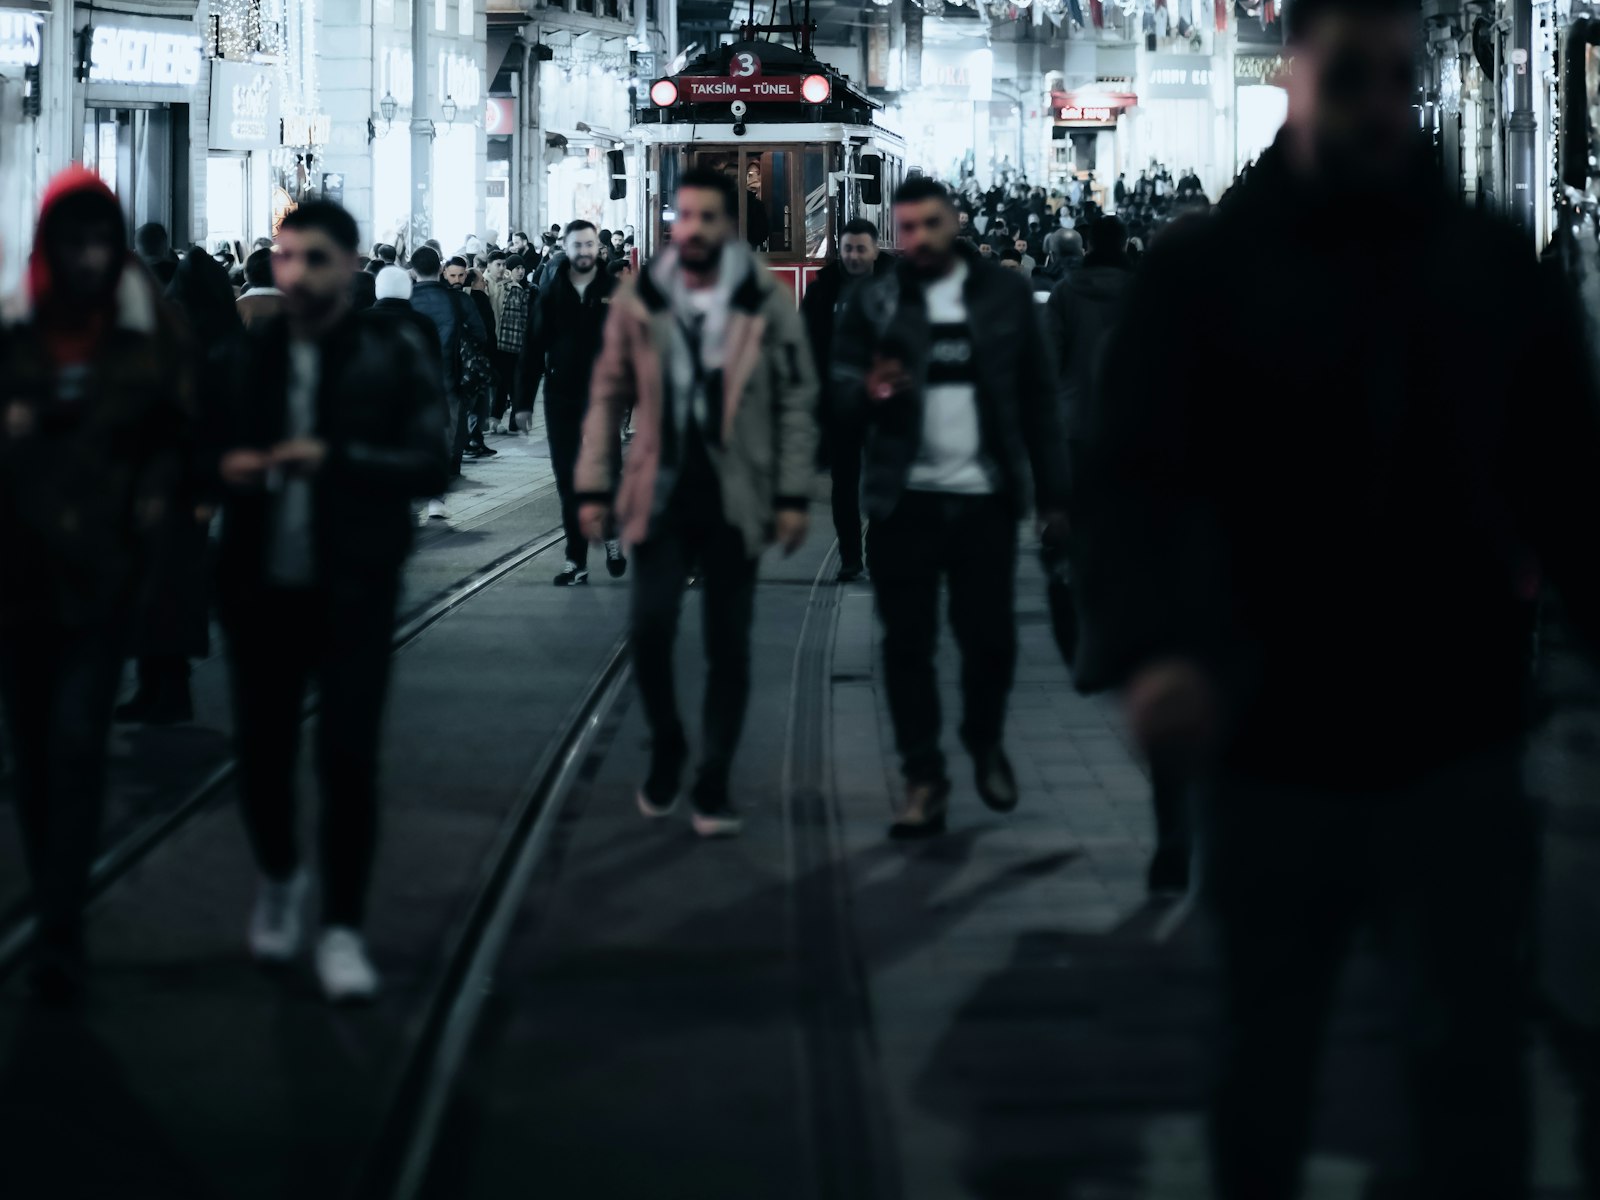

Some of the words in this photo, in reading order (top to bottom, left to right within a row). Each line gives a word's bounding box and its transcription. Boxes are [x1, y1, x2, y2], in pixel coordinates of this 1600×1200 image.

[738, 53, 755, 77] 3
[691, 82, 736, 94] TAKSİM
[753, 82, 794, 94] TÜNEL
